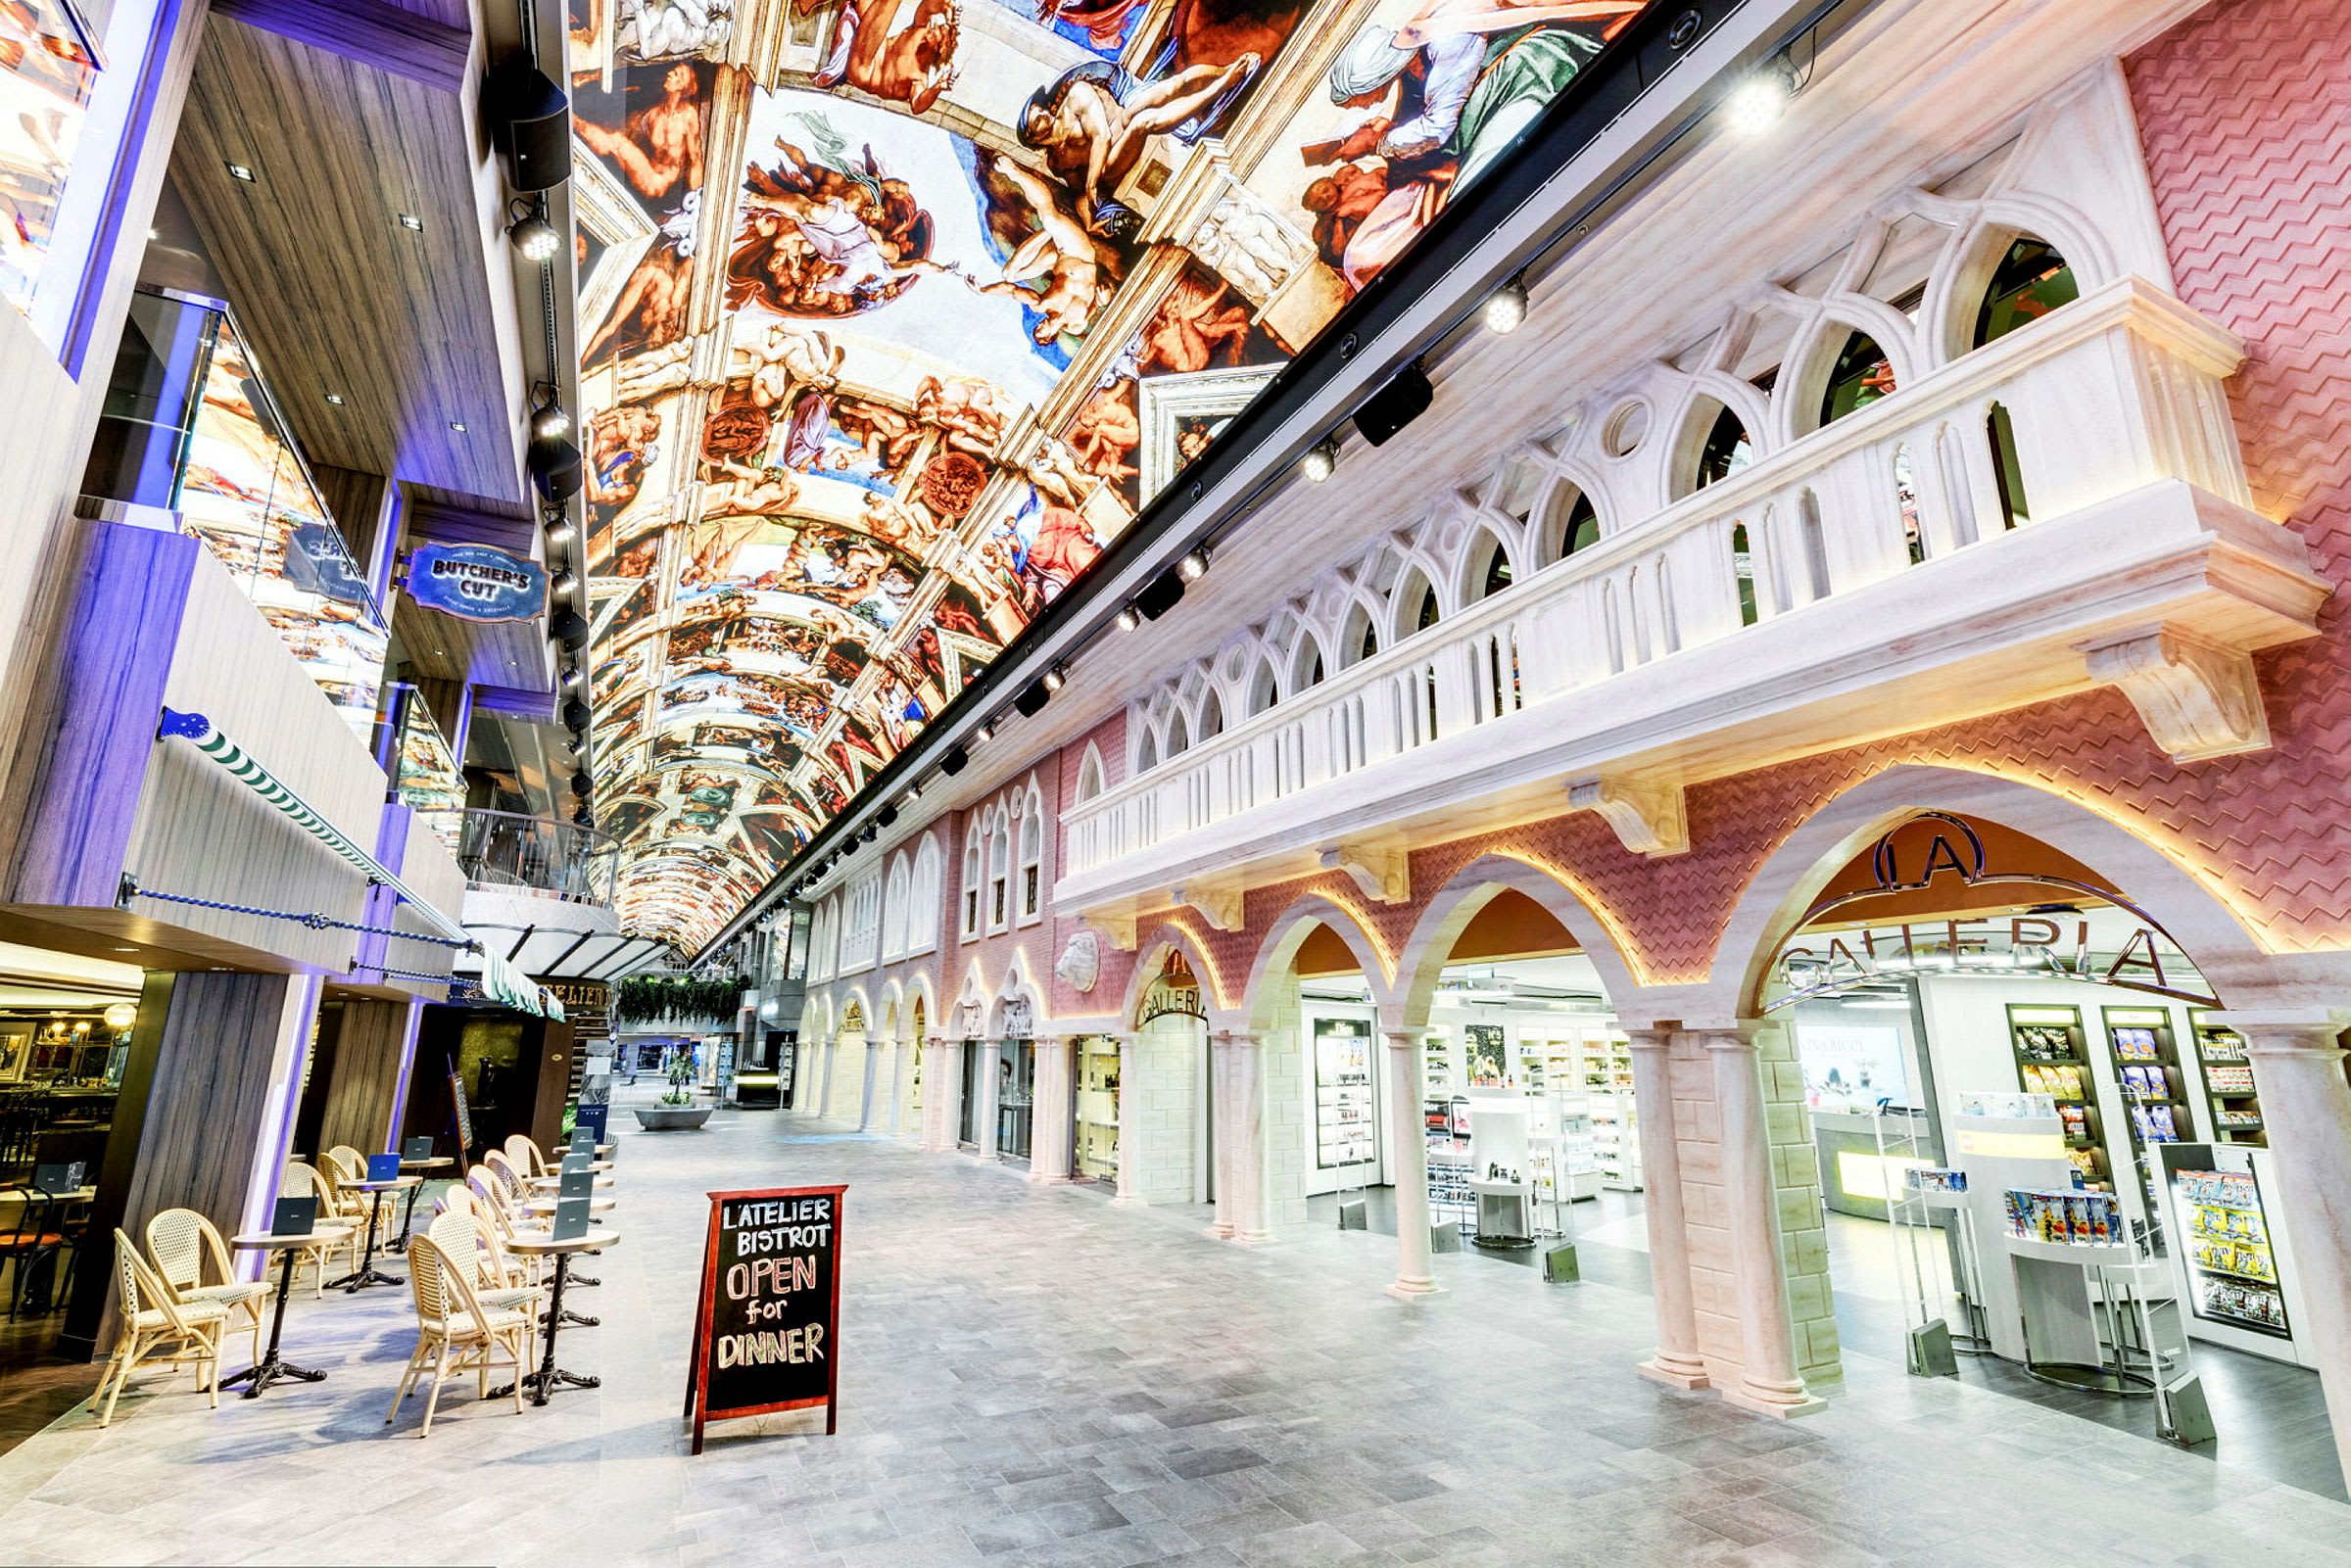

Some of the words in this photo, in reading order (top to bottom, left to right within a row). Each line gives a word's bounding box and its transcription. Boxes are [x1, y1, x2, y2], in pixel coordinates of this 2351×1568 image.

[432, 559, 531, 592] BUTCHER'S
[459, 580, 499, 601] CUT
[1778, 916, 2168, 990] GALLERIA
[737, 1223, 832, 1257] BISTROT
[726, 1254, 817, 1300] OPEN
[744, 1299, 788, 1325] for
[717, 1322, 825, 1369] DINNER
